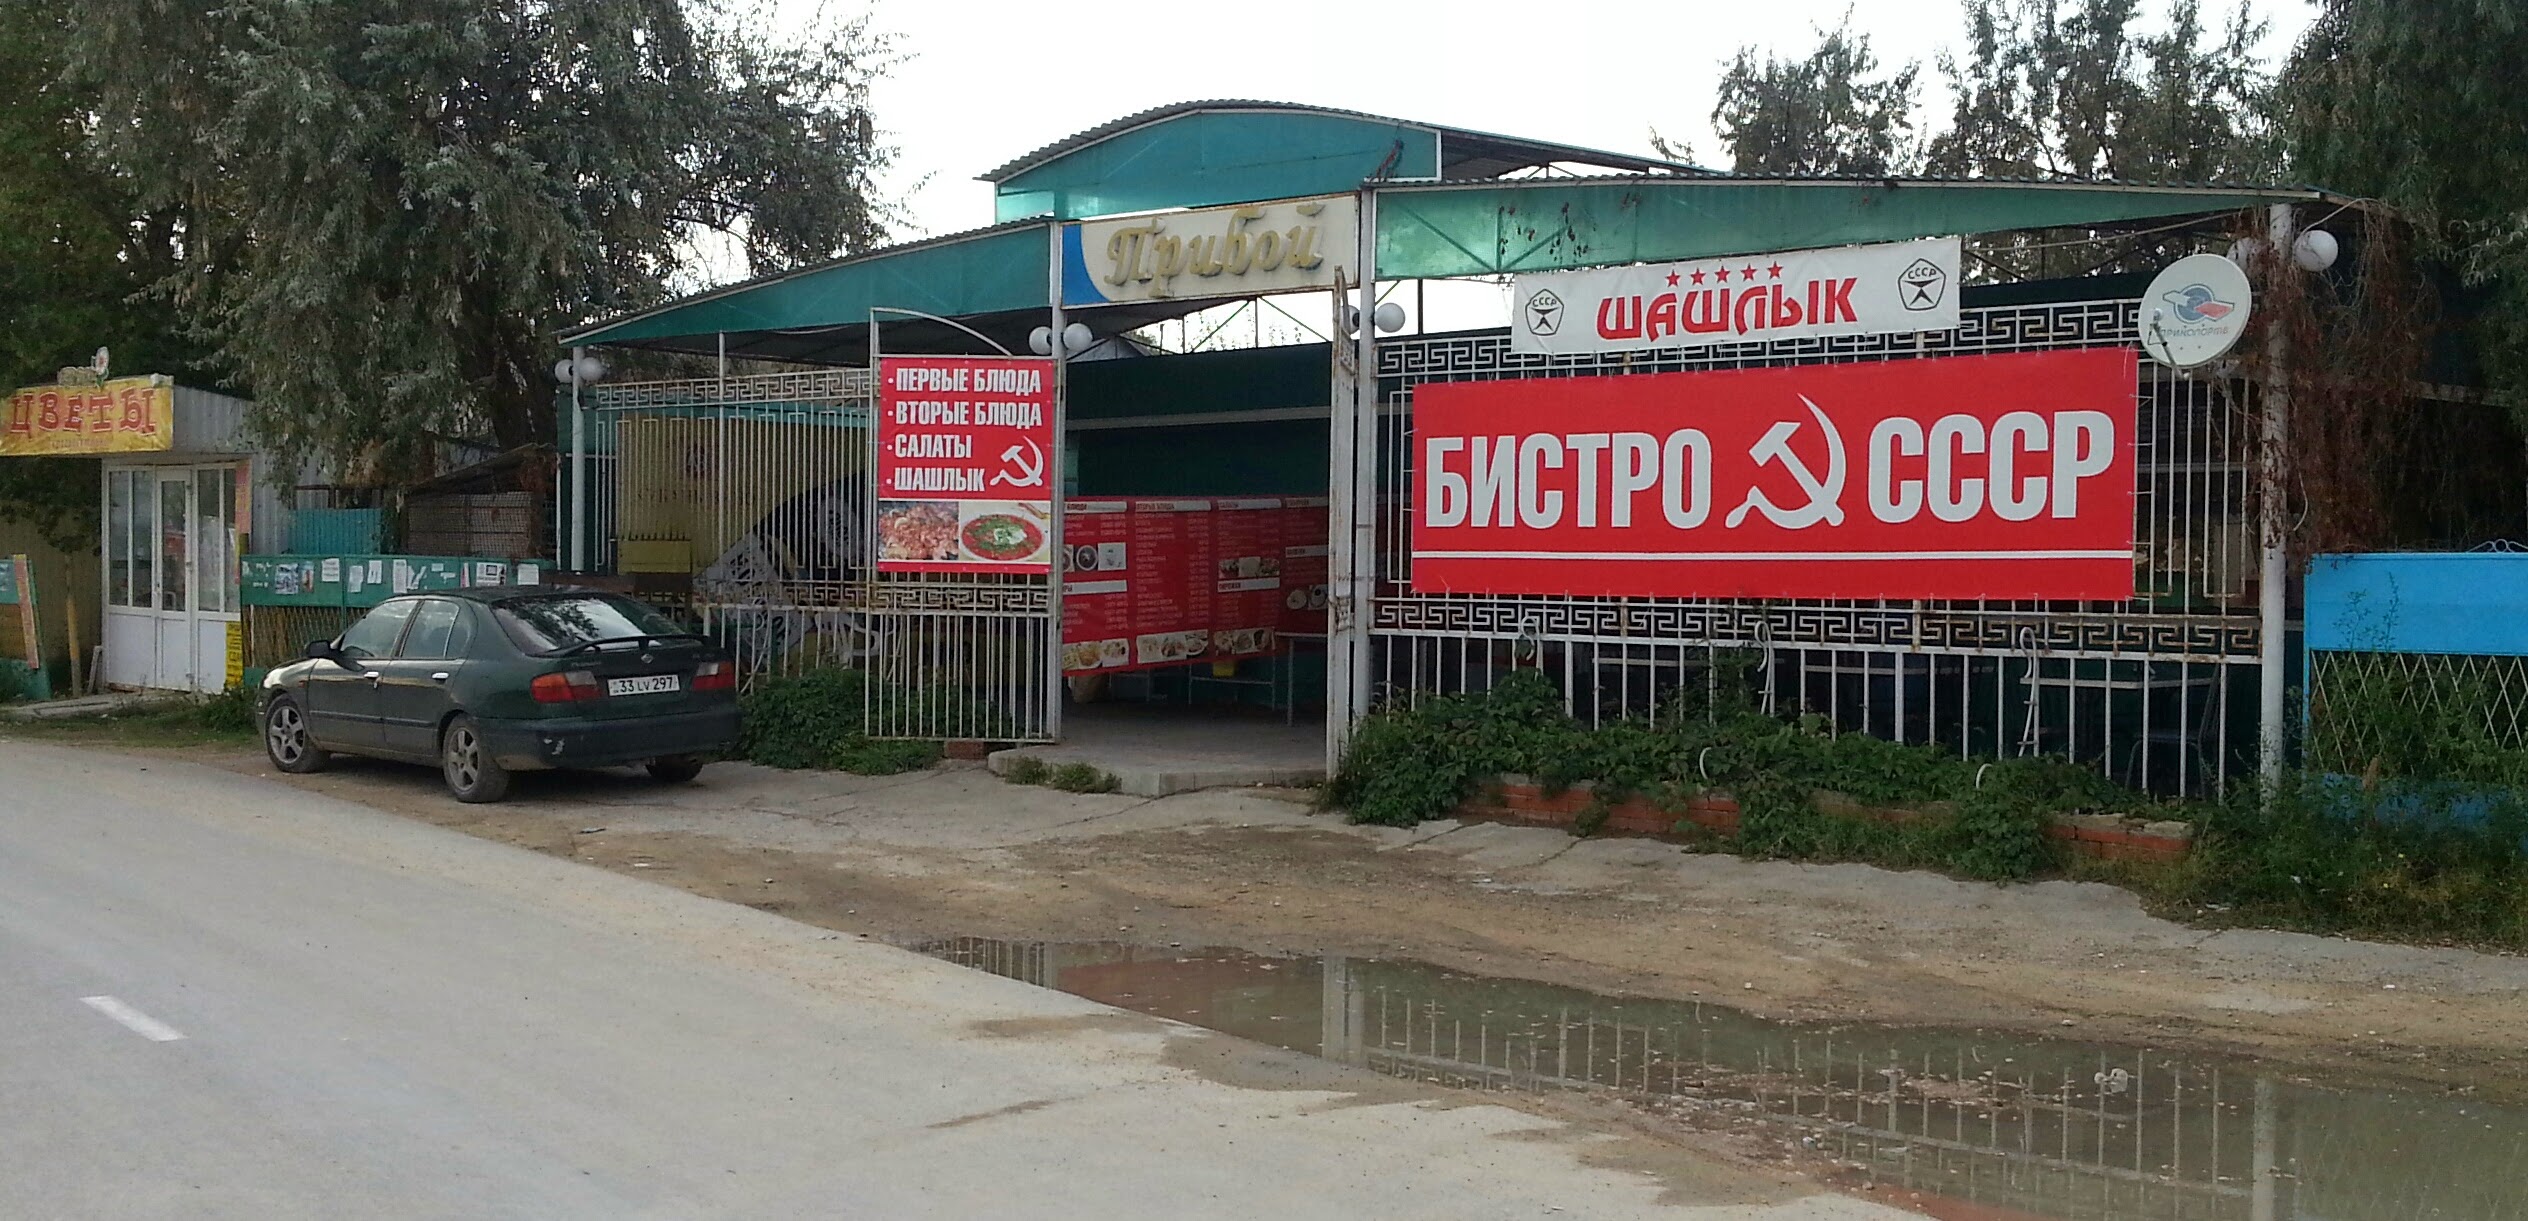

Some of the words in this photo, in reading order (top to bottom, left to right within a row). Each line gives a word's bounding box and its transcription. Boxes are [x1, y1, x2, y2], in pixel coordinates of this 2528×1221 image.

[1105, 202, 1325, 297] Прибой
[1907, 267, 1937, 280] СССР
[1532, 297, 1557, 307] СССР
[1596, 279, 1859, 342] ШАШЛЫК
[895, 368, 968, 391] ПЕРВЫЕ
[973, 369, 1041, 396] БЛЮДА
[10, 388, 156, 438] ЦВЕТЫ
[895, 401, 969, 425] ВТОРЫЕ
[974, 402, 1042, 429] БЛЮДА
[894, 434, 972, 458] САЛАТЫ
[894, 467, 985, 491] ШАШЛЫК
[1425, 429, 1712, 531] БИСТРО
[1867, 411, 2114, 523] СССР
[620, 680, 634, 693] 33
[637, 682, 650, 692] LV
[652, 677, 673, 691] 297
